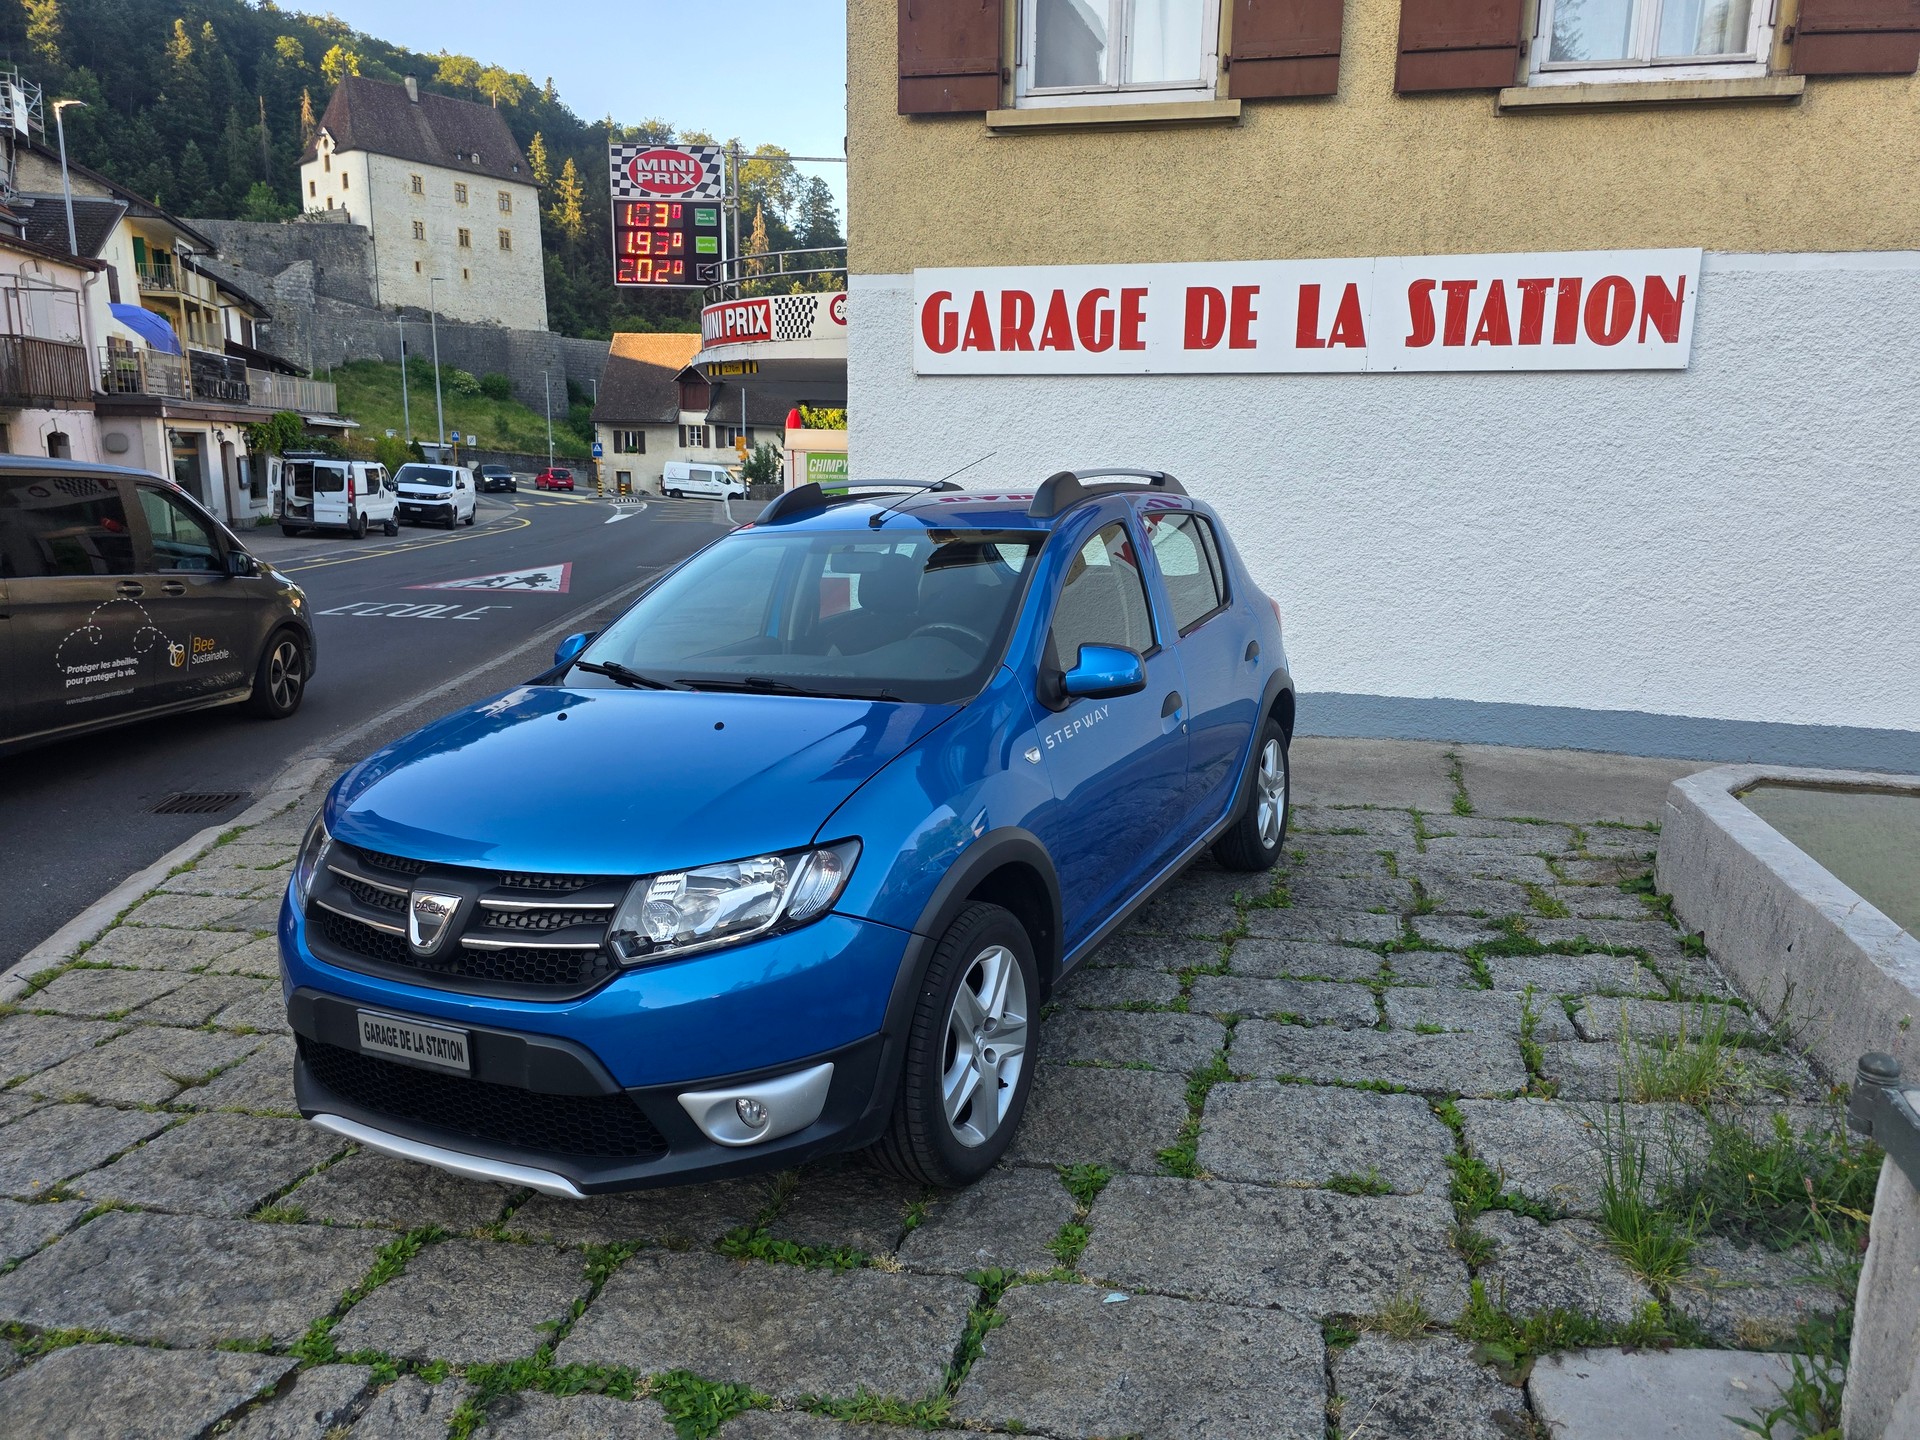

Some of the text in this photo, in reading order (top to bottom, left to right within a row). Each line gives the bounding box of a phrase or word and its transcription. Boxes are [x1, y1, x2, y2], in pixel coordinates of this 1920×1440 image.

[636, 158, 695, 172] MINI
[636, 172, 696, 185] PRIX
[921, 274, 1687, 354] GARAGE DE LA STATION
[703, 304, 769, 343] MINI PRIX
[809, 458, 848, 473] CHIMPY
[314, 602, 513, 620] ECOLE
[192, 636, 216, 653] Bee
[191, 648, 230, 665] Sustainable
[66, 657, 139, 675] Protéger les abeilles,
[66, 668, 137, 688] pour protéger la vie.
[1045, 704, 1109, 750] STEPWAY
[414, 901, 447, 915] DACIA
[364, 1021, 464, 1062] GARAGE DE LA STATION
